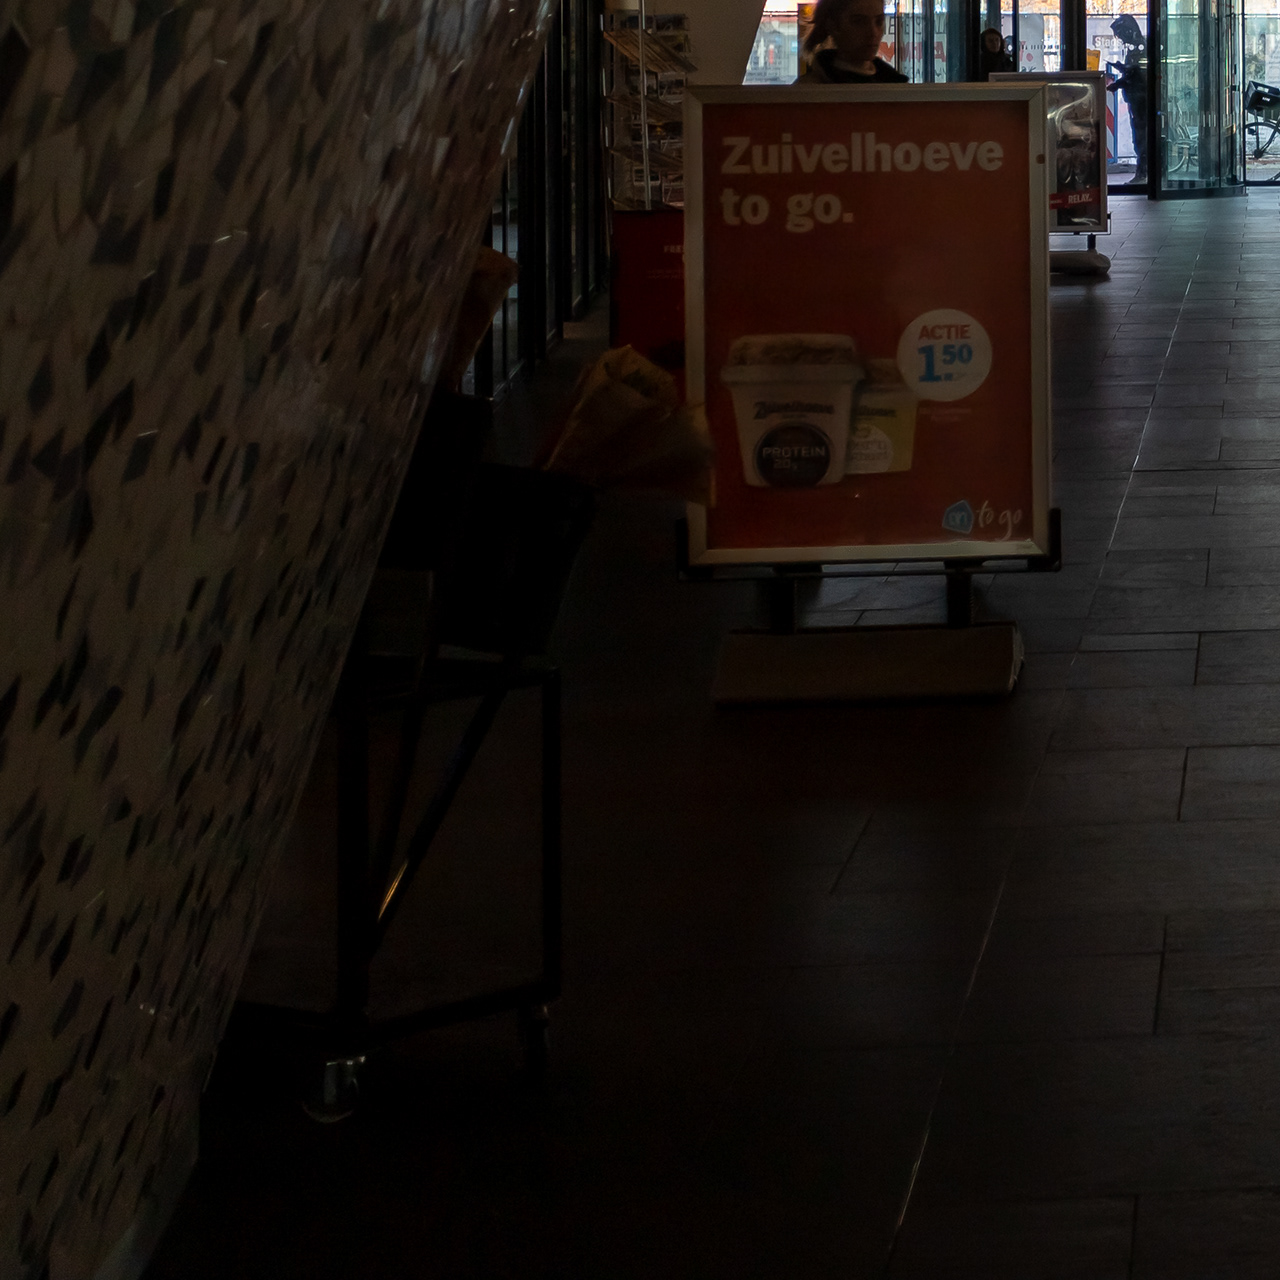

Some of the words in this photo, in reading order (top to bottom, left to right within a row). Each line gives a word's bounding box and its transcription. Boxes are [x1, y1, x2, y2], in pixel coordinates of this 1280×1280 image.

[720, 131, 1005, 175] Zuivelhoeve
[719, 187, 770, 226] to
[785, 192, 854, 234] go.
[917, 324, 972, 340] ACTIE
[761, 446, 826, 459] PROTEIN
[975, 500, 995, 528] to
[998, 509, 1023, 541] go
